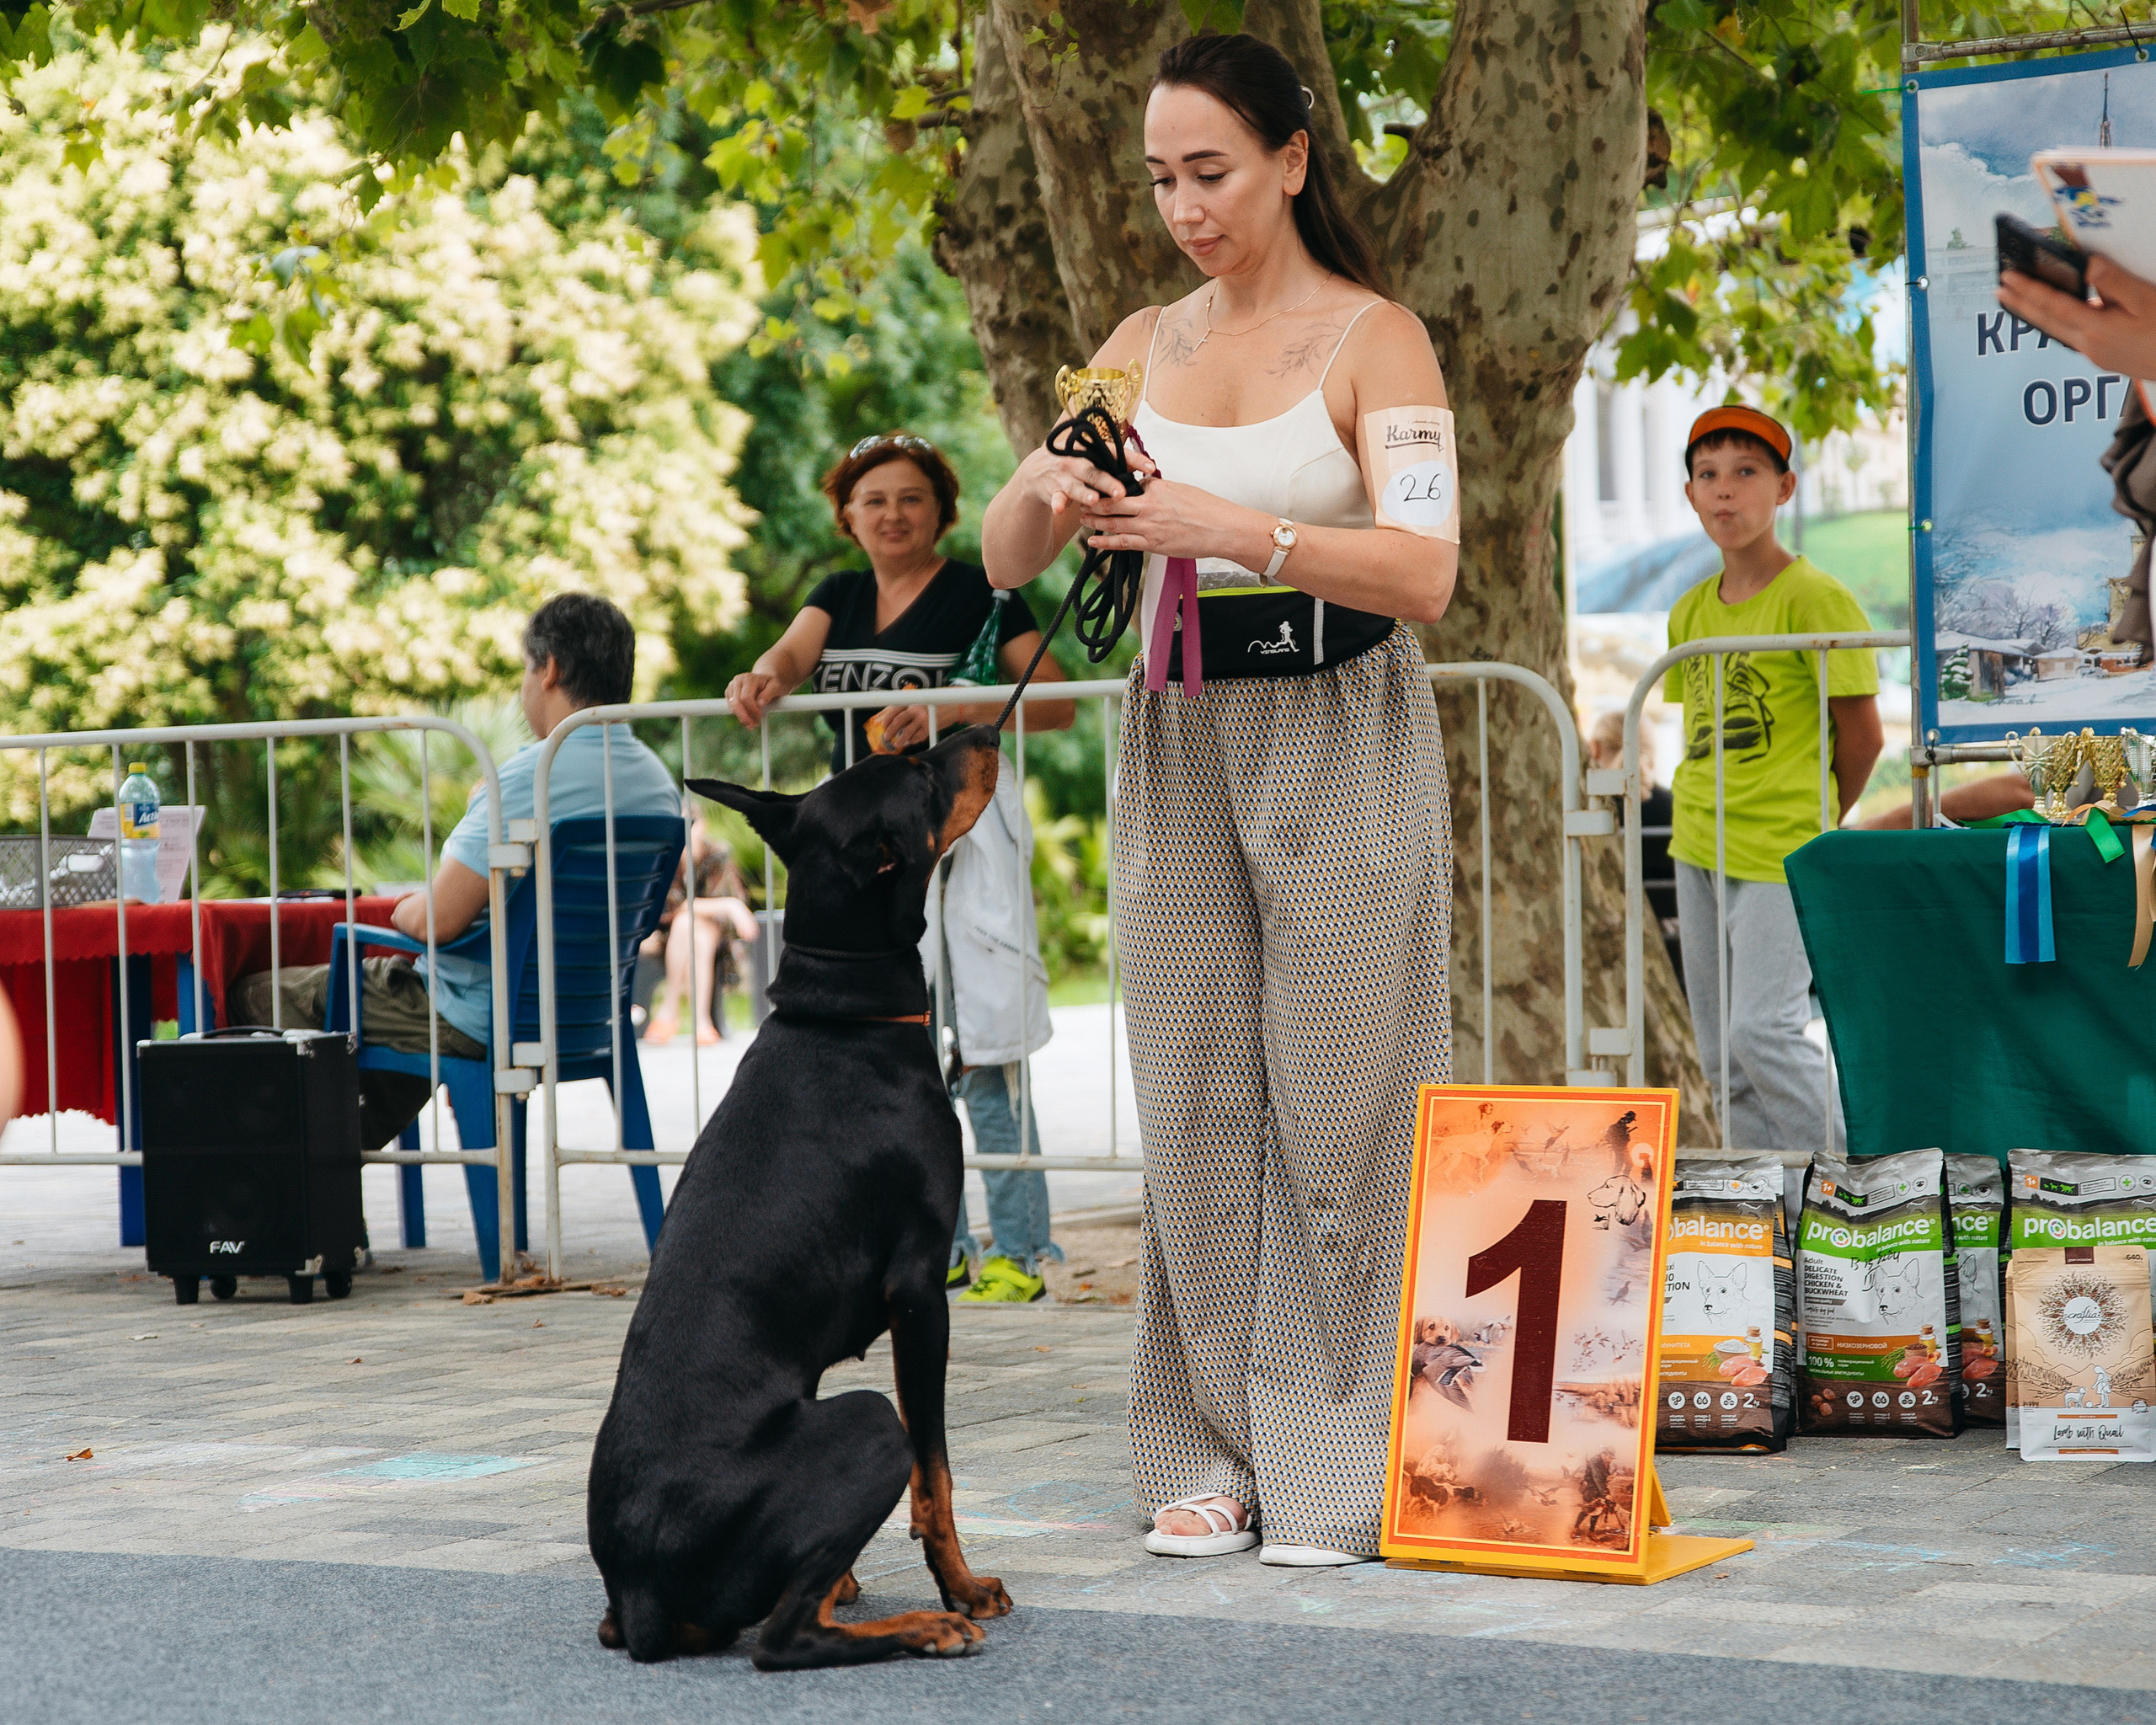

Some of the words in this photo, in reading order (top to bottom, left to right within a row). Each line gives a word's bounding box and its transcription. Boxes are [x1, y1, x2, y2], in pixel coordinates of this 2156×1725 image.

[1977, 311, 2050, 355] КР
[2023, 374, 2130, 425] ОРГ
[1386, 425, 1444, 452] Karmy
[1400, 473, 1441, 502] 26
[2026, 1178, 2036, 1186] 1+
[1806, 1219, 1930, 1248] probalance
[210, 1240, 245, 1254] FAV
[1804, 1257, 1823, 1265] Adult
[1804, 1264, 1838, 1274] DELICATE
[1804, 1273, 1844, 1282] DIGESTION
[1804, 1279, 1835, 1289] CHICKEN
[1804, 1287, 1849, 1296] BUCKWHEAT
[1465, 1199, 1567, 1444] 1
[1808, 1356, 1822, 1367] 100
[1823, 1357, 1835, 1368] %
[2077, 1425, 2095, 1440] with
[2099, 1424, 2125, 1440] Quail
